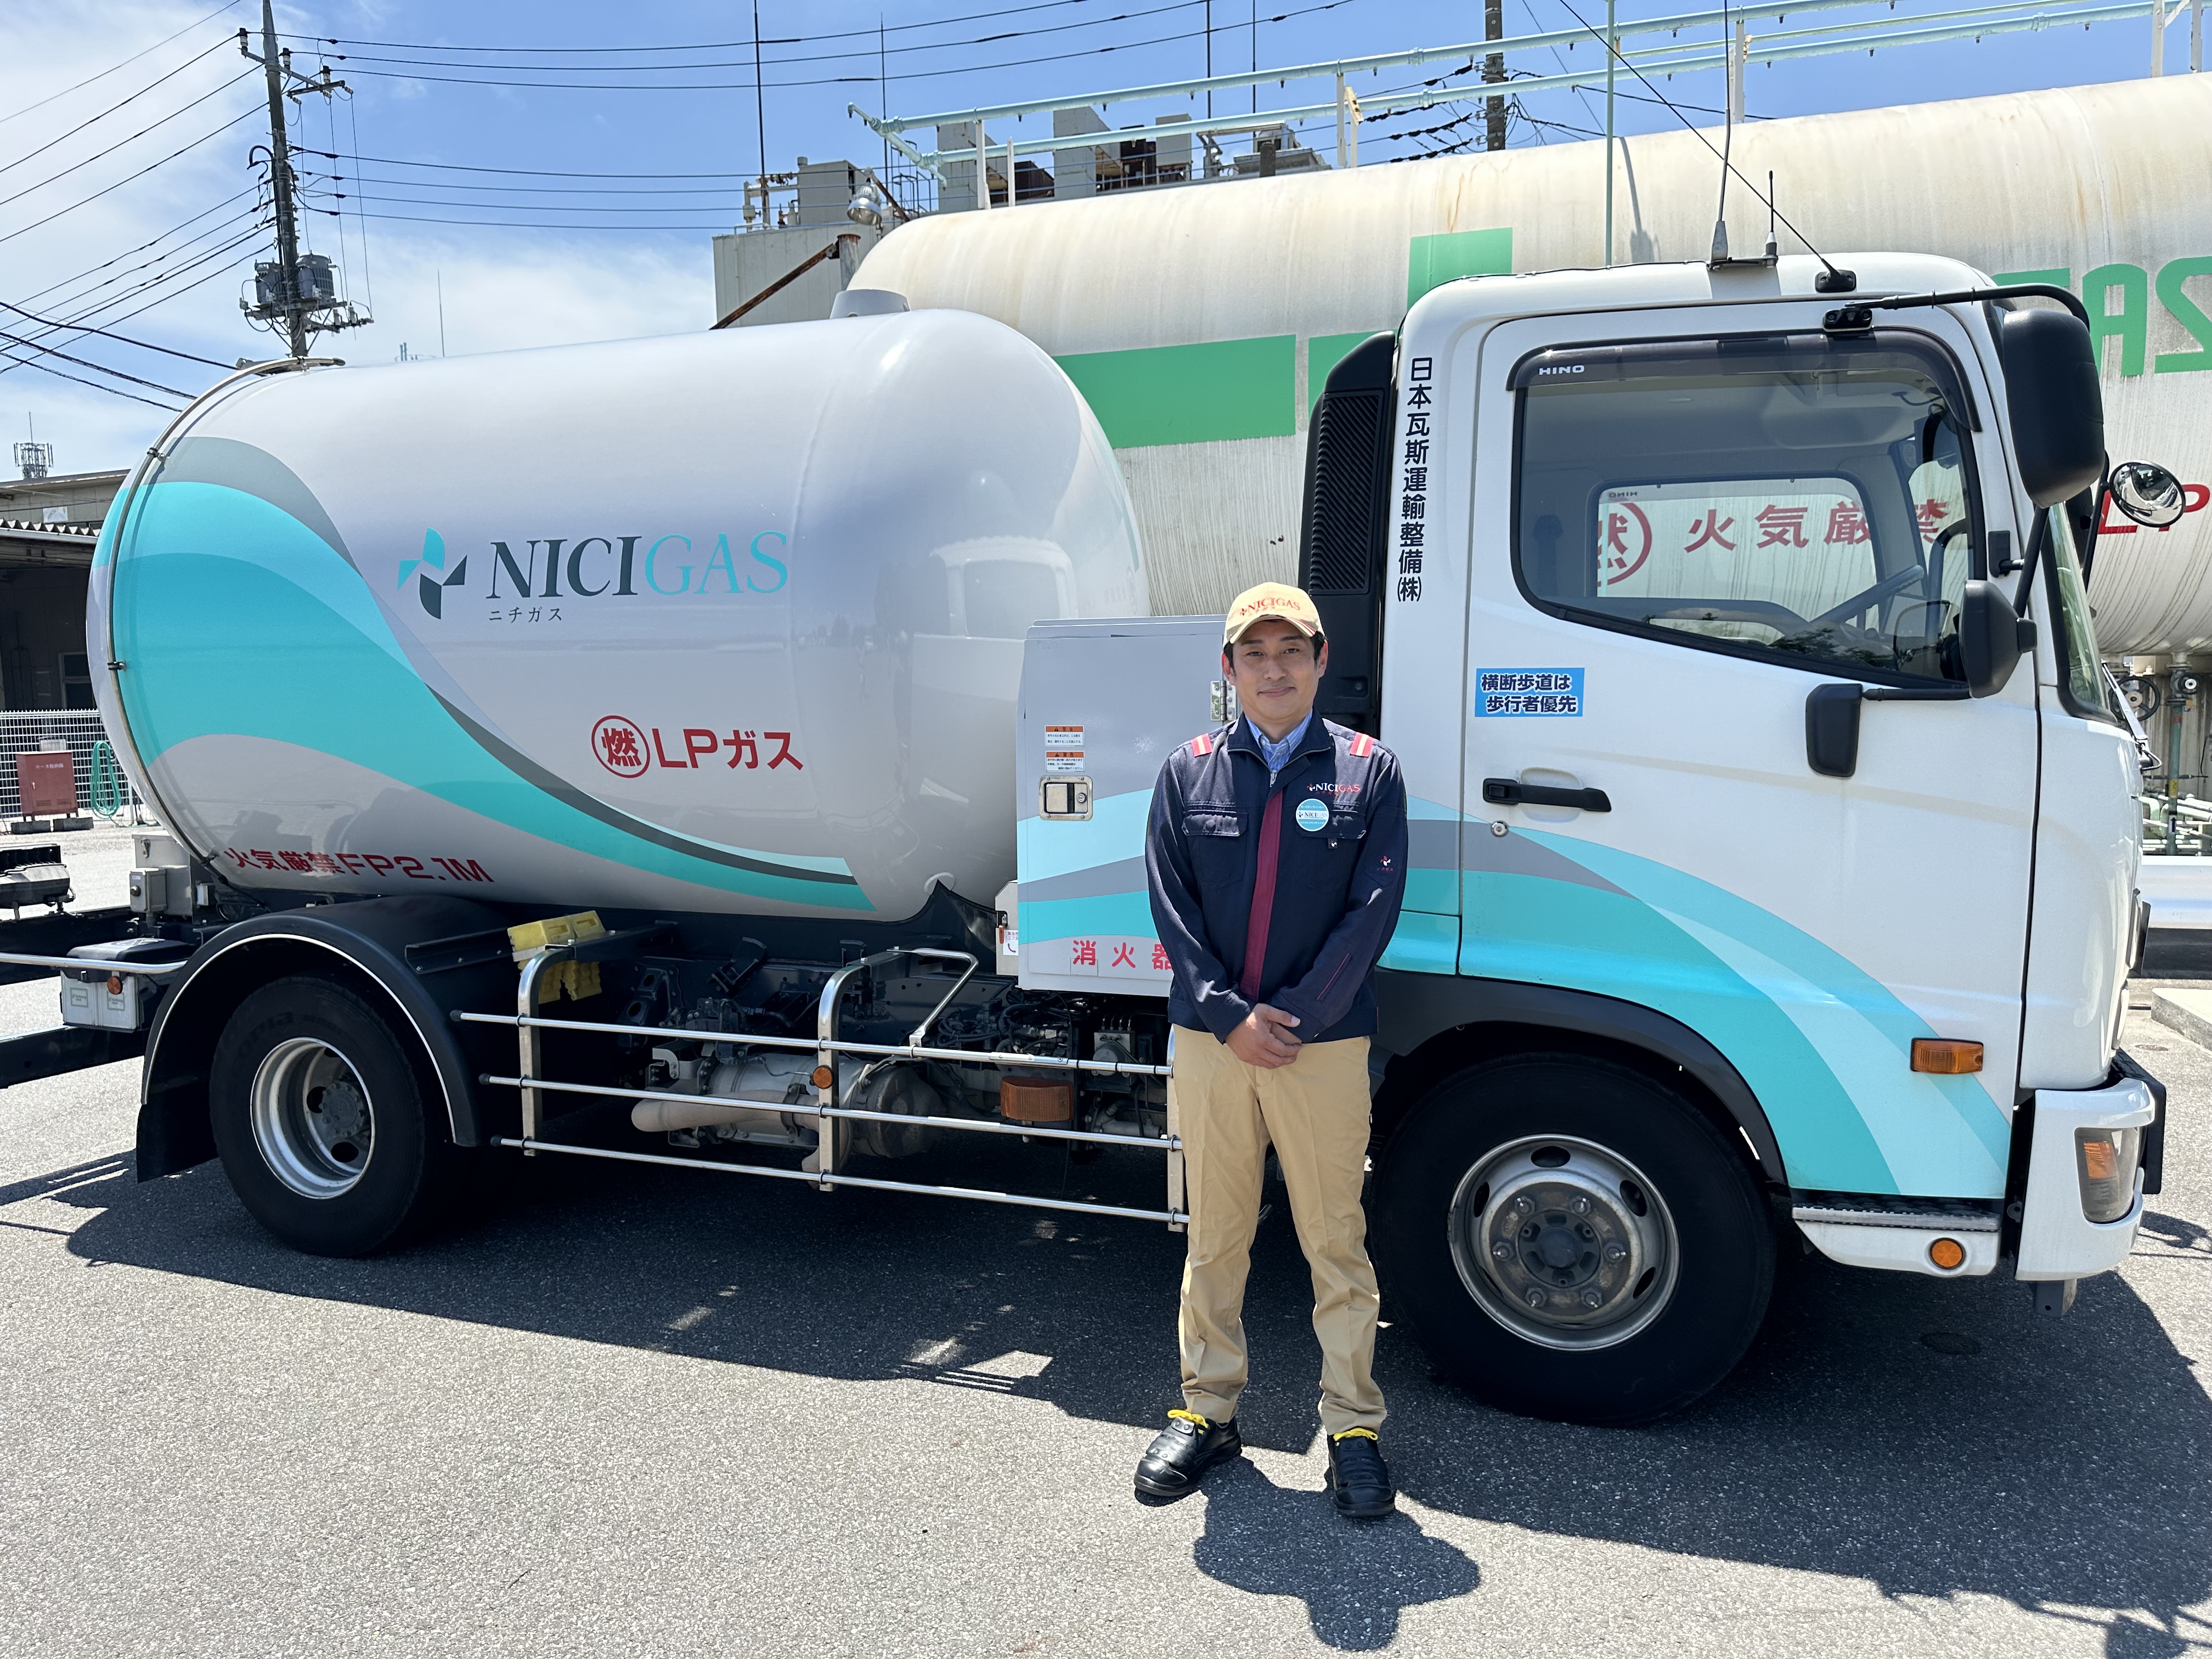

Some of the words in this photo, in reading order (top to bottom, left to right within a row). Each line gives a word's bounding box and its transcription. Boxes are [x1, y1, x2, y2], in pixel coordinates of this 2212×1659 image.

[1990, 256, 2212, 377] AS
[1539, 364, 1585, 376] HINO
[486, 530, 788, 599] NICIGAS
[1248, 597, 1300, 612] NICIGAS
[488, 606, 563, 624] ニチガス
[1481, 673, 1571, 691] 横断歩道は
[1486, 695, 1577, 713] 歩行者優先
[652, 727, 804, 771] LPガス
[1315, 782, 1361, 792] NICIGAS
[1073, 940, 1173, 970] 消火器
